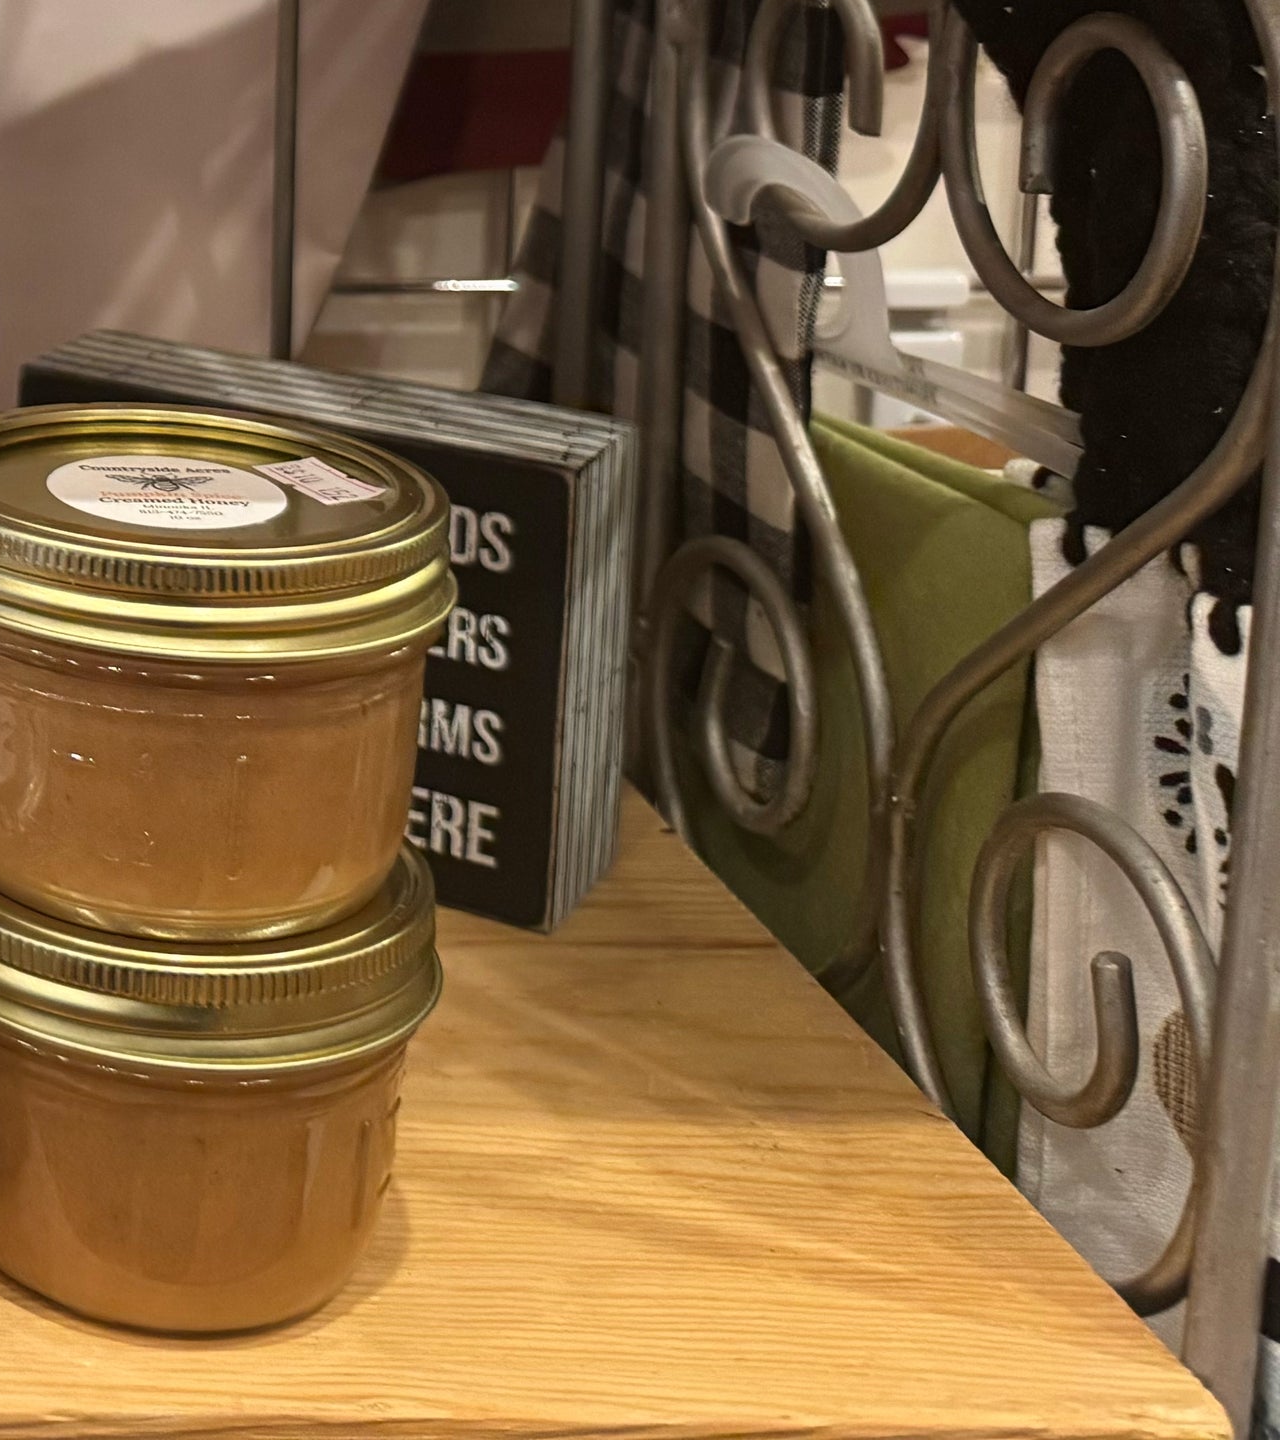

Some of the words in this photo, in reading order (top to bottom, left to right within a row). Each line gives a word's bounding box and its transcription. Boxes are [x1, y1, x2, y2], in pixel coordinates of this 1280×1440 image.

[78, 464, 180, 474] Countryside
[185, 466, 231, 474] Acres
[99, 496, 183, 504] Creamed
[189, 498, 250, 507] Honey
